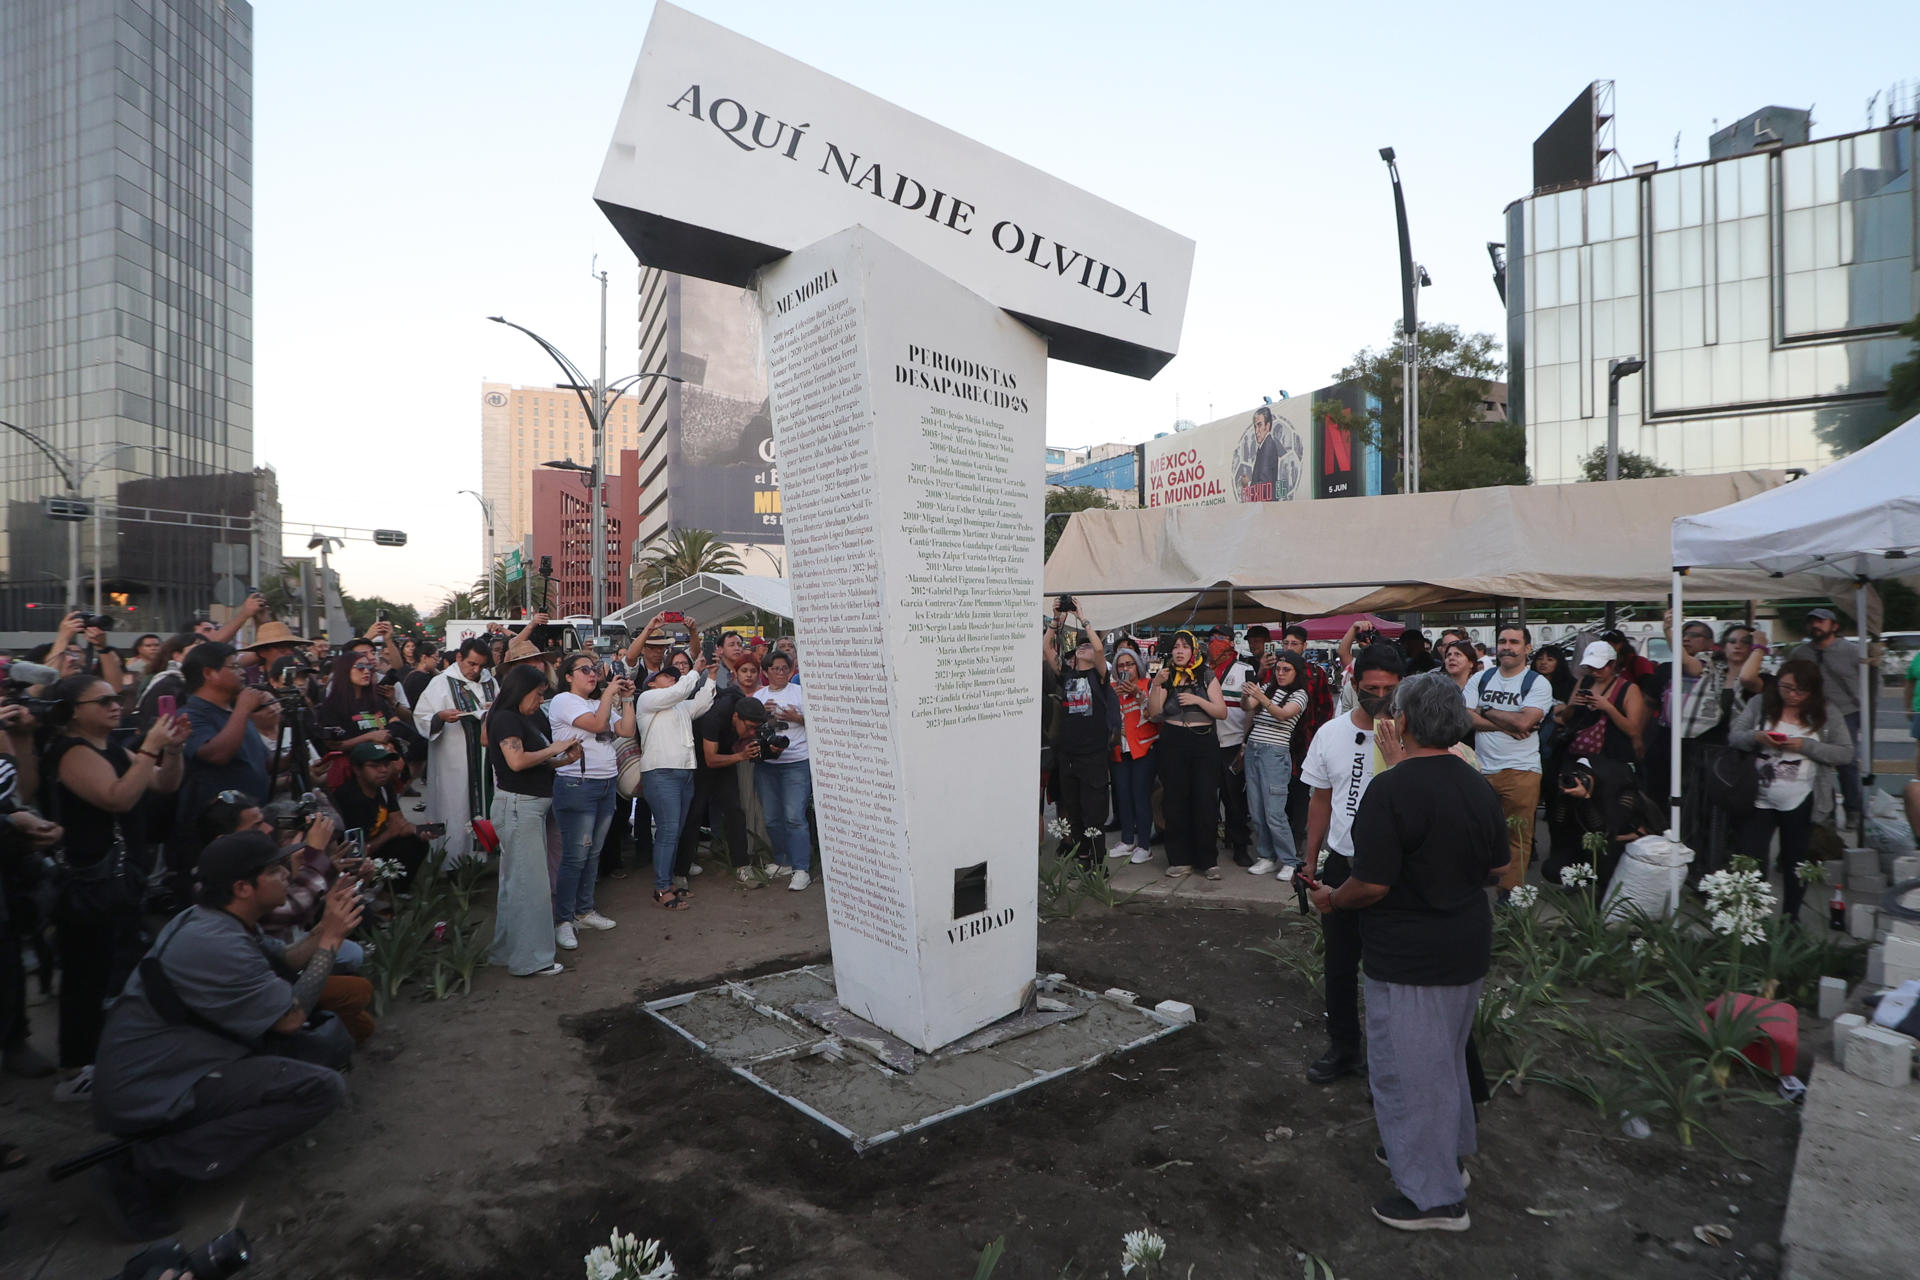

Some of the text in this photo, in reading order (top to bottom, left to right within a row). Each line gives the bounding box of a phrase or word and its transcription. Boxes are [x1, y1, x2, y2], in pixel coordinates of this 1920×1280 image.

[667, 83, 1152, 316] AQUÍ NADIE OLVIDA
[776, 268, 839, 318] MEMORIA
[908, 344, 1017, 390] PERIODISTAS
[948, 410, 963, 419] Jesús
[965, 413, 980, 424] Mejía
[948, 445, 967, 455] Rafael
[935, 454, 948, 464] José
[1150, 448, 1197, 474] MÉXICO
[908, 474, 934, 485] Paredes
[1150, 464, 1205, 489] YA GANÓ
[1328, 482, 1348, 492] 5 JUN
[944, 491, 971, 501] Mauricio
[972, 495, 994, 504] Estrada
[1150, 480, 1226, 508] EL MUNDIAL.
[916, 500, 933, 509] 2009
[956, 504, 975, 514] Esther
[978, 508, 997, 517] Aguilar
[903, 511, 918, 520] 2010
[922, 513, 944, 524] Miguel
[930, 526, 960, 535] Guillermo
[932, 538, 961, 547] Francisco
[962, 541, 992, 551] Guadalupe
[988, 554, 1006, 564] Ortega
[926, 562, 939, 570] 2011
[942, 563, 962, 571] Marco
[908, 574, 932, 582] Manuel
[933, 575, 957, 583] Gabriel
[958, 575, 984, 585] Figueroa
[911, 586, 925, 594] 2012
[953, 587, 968, 597] Puga
[971, 587, 986, 595] Tovar
[915, 611, 924, 619] les
[954, 610, 969, 618] Adela
[908, 623, 923, 632] 2013
[926, 624, 946, 633] Sergio
[919, 635, 933, 643] 2014
[938, 646, 956, 654] Mario
[951, 670, 966, 679] Jorge
[937, 682, 954, 690] Pablo
[955, 680, 972, 690] Felipe
[918, 695, 933, 704] 2022
[961, 690, 981, 699] Cristal
[911, 708, 932, 717] Carlos
[954, 703, 979, 711] Mendoza
[926, 718, 940, 728] 2023
[957, 714, 976, 723] Carlos
[1347, 752, 1366, 817] ¡JUSTICIA!
[947, 907, 1015, 946] VERDAD
